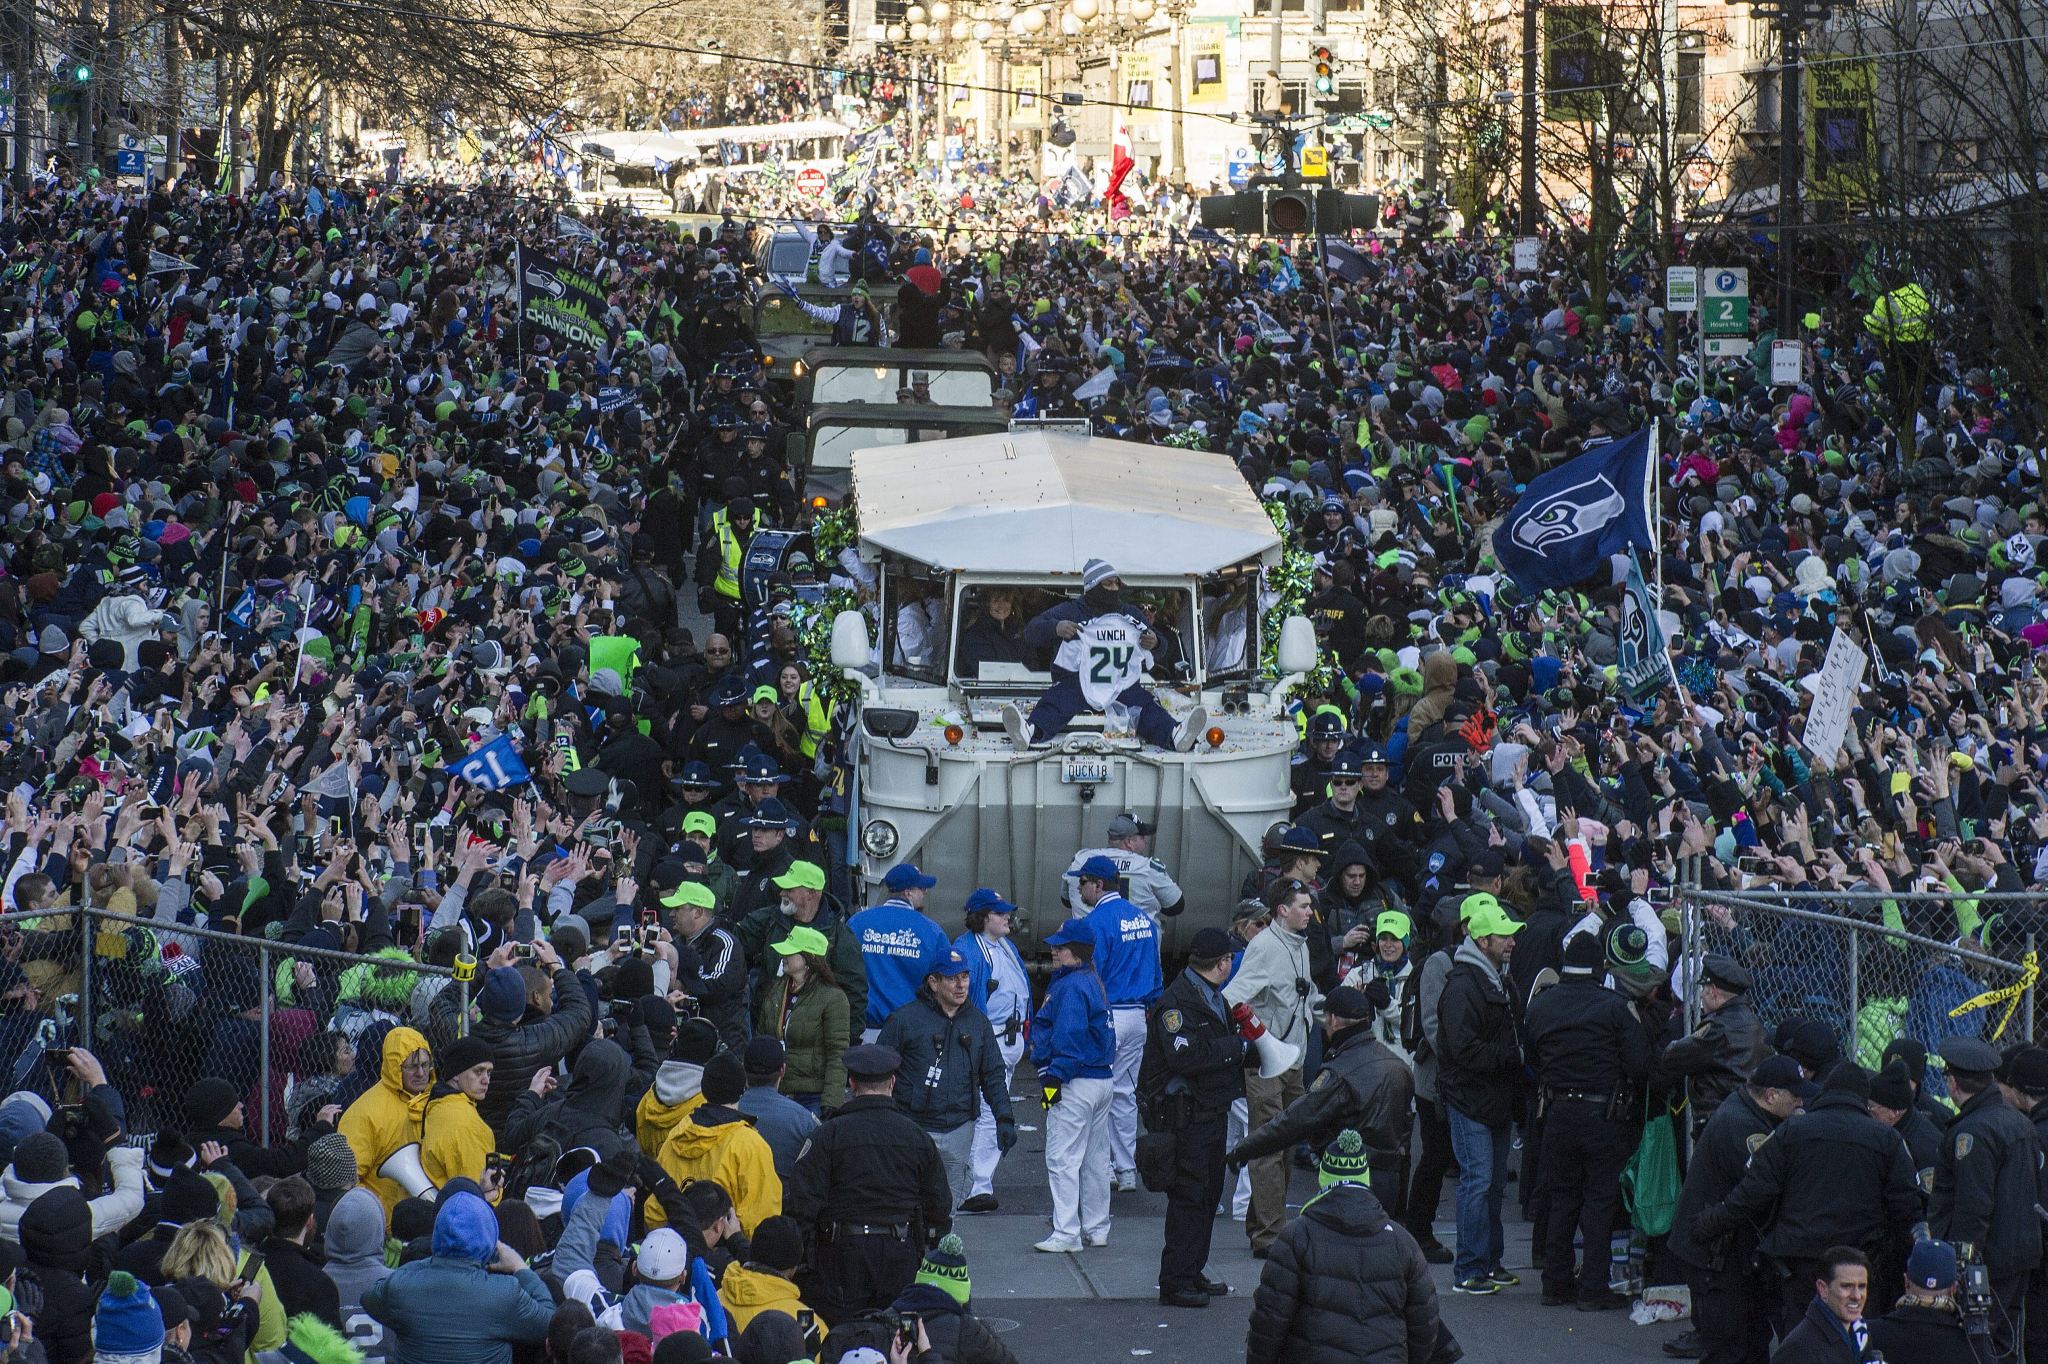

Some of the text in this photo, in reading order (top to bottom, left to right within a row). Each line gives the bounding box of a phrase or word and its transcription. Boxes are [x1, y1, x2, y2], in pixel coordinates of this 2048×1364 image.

[126, 153, 136, 166] 2
[1721, 275, 1733, 289] P
[1720, 300, 1734, 321] 2
[526, 307, 607, 351] CHAMPIONS
[1097, 629, 1126, 641] LYNCH
[1089, 646, 1135, 684] 24
[557, 737, 568, 746] 12
[861, 943, 921, 959] PARADE MARSHALS
